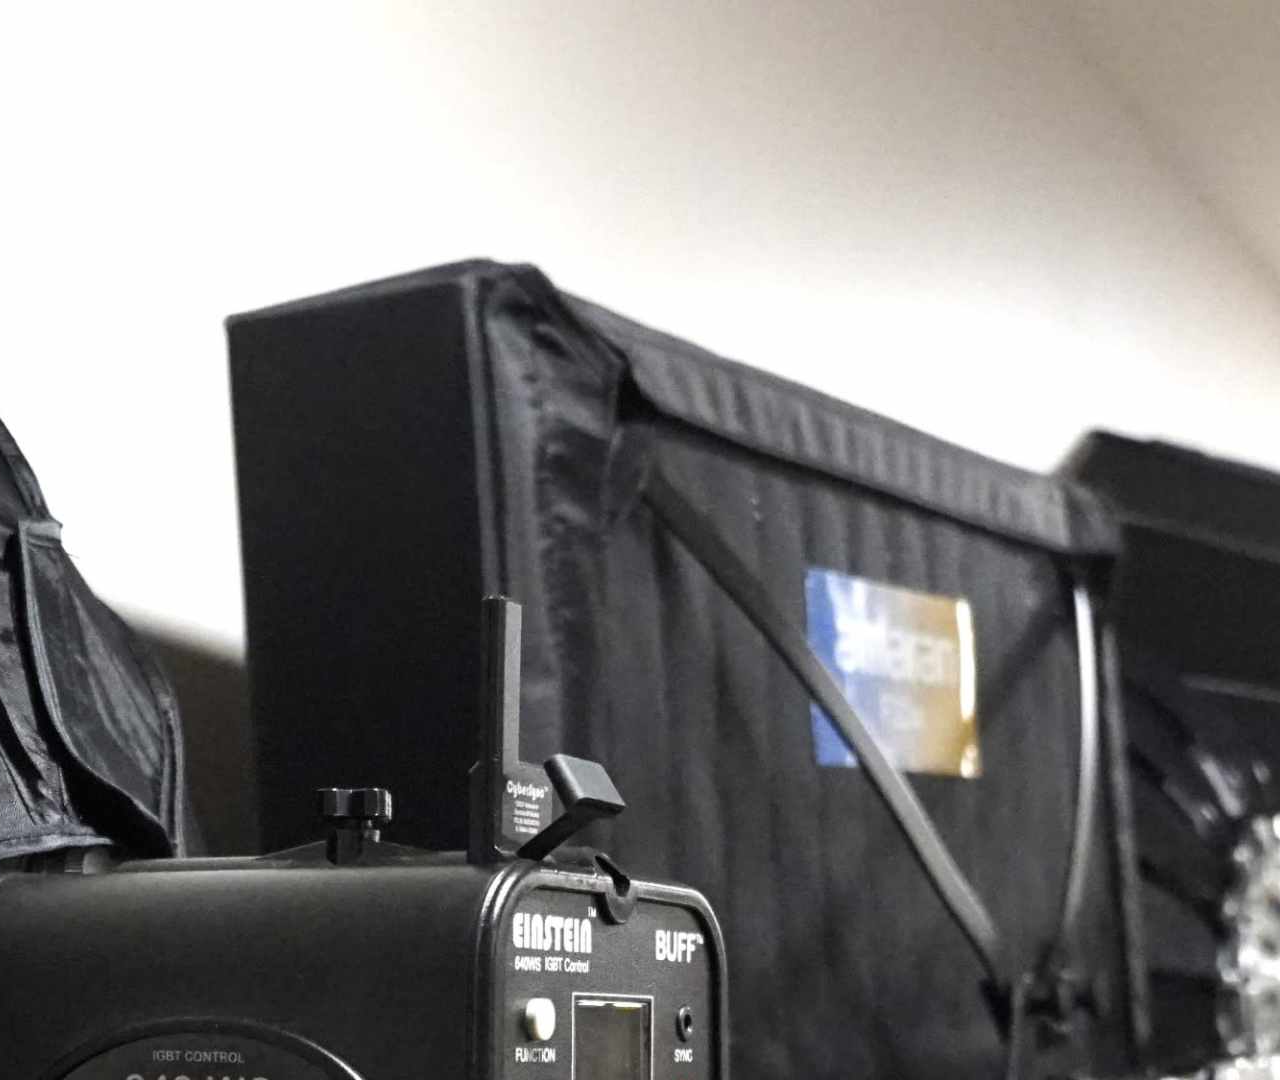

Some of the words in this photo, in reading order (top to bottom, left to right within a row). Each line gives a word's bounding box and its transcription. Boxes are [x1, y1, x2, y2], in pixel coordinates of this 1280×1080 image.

[544, 956, 564, 972] IGBT
[564, 957, 589, 974] Control
[153, 1050, 182, 1063] IGBT
[184, 1051, 245, 1065] CONTROL
[515, 1047, 556, 1063] FUNCTION
[674, 1048, 693, 1063] SYNC
